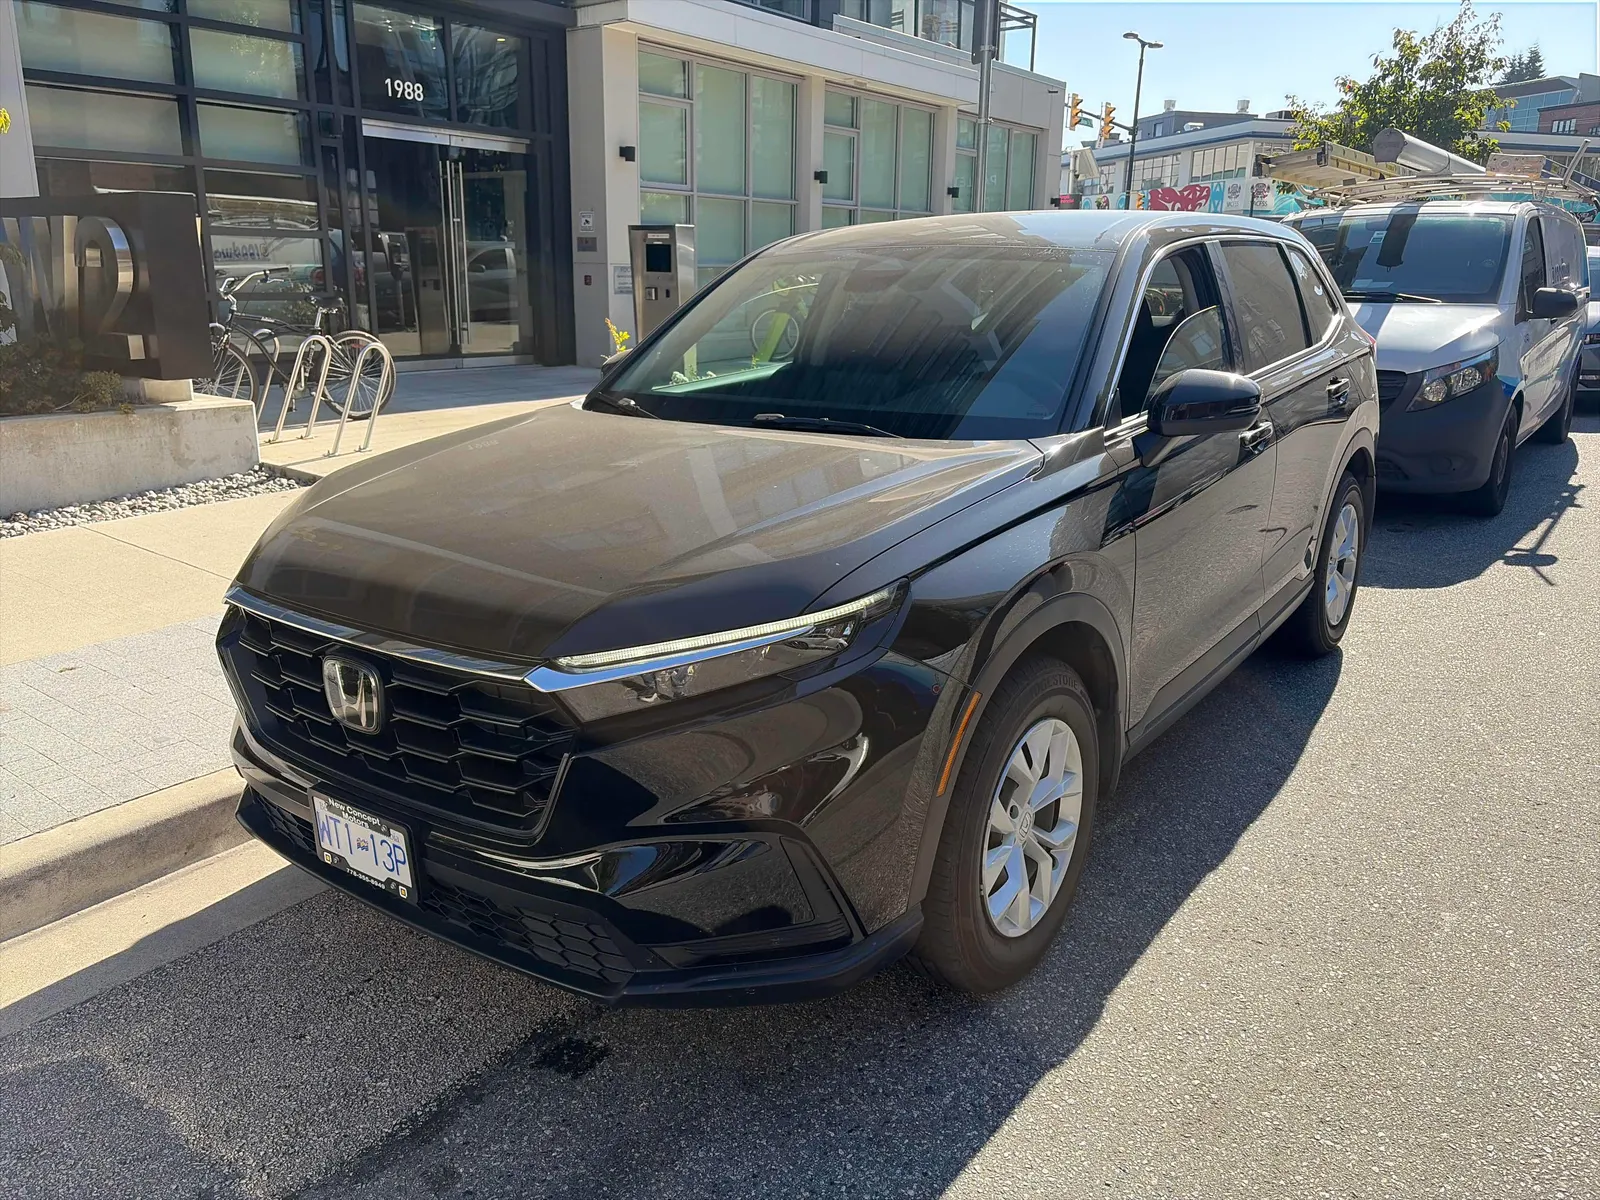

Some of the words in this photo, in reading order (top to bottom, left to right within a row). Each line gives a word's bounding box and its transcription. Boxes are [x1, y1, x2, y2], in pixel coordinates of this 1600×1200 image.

[385, 78, 424, 102] 1988
[328, 797, 346, 811] New
[346, 805, 381, 827] Concept
[341, 811, 370, 829] Motors
[316, 810, 353, 855] WT1
[369, 833, 407, 876] 13P
